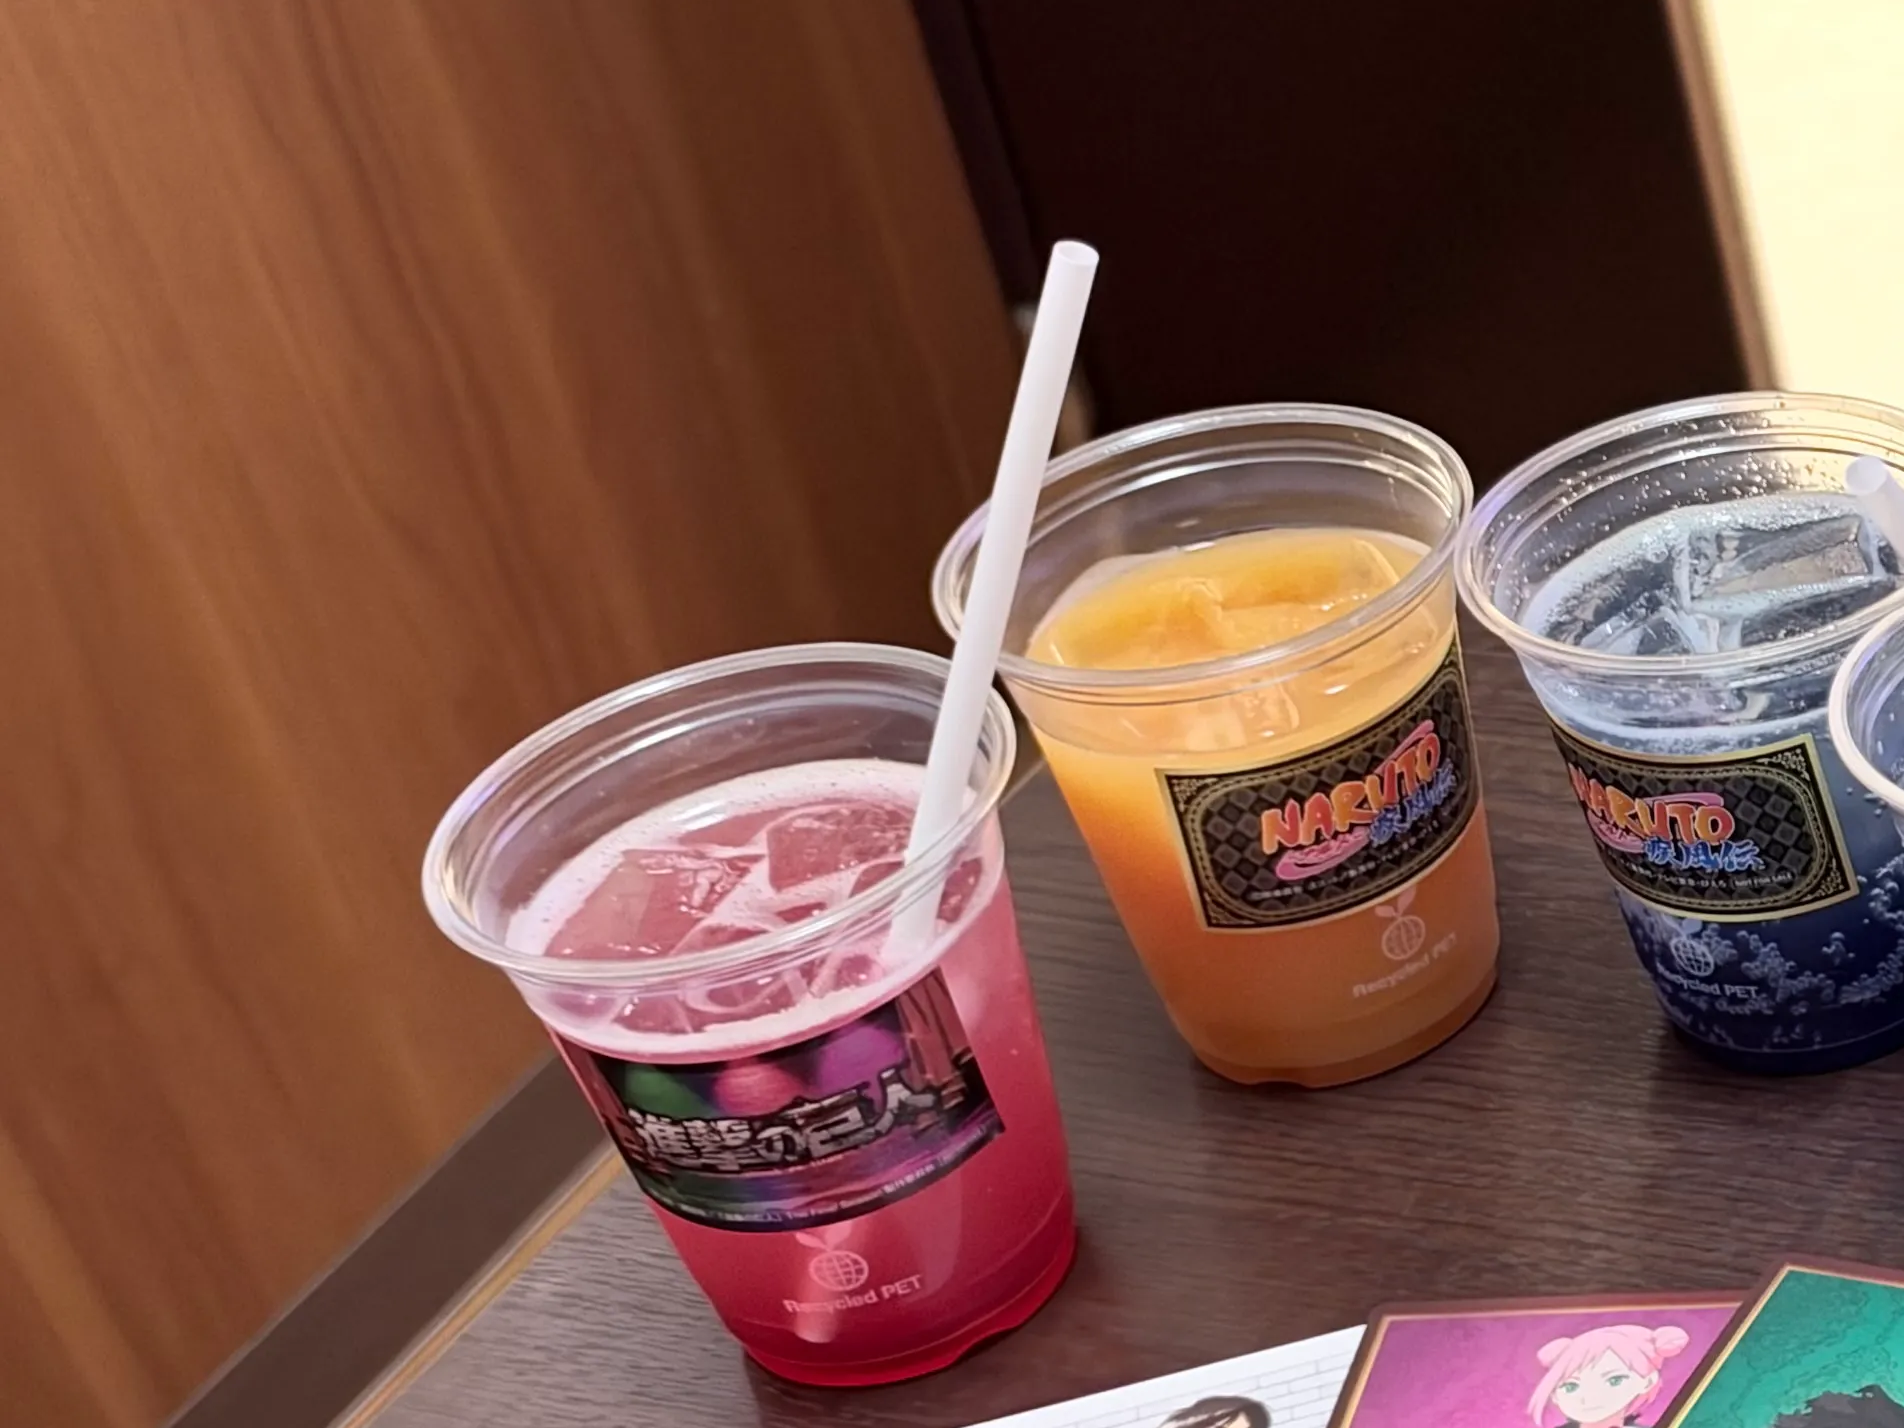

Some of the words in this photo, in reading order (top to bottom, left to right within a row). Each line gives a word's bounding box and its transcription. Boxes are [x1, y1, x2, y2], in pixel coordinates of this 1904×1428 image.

[1261, 732, 1442, 856] NARUTO
[628, 1069, 935, 1172] 進撃の巨人
[782, 1287, 878, 1316] Recycled
[881, 1274, 922, 1299] PET
